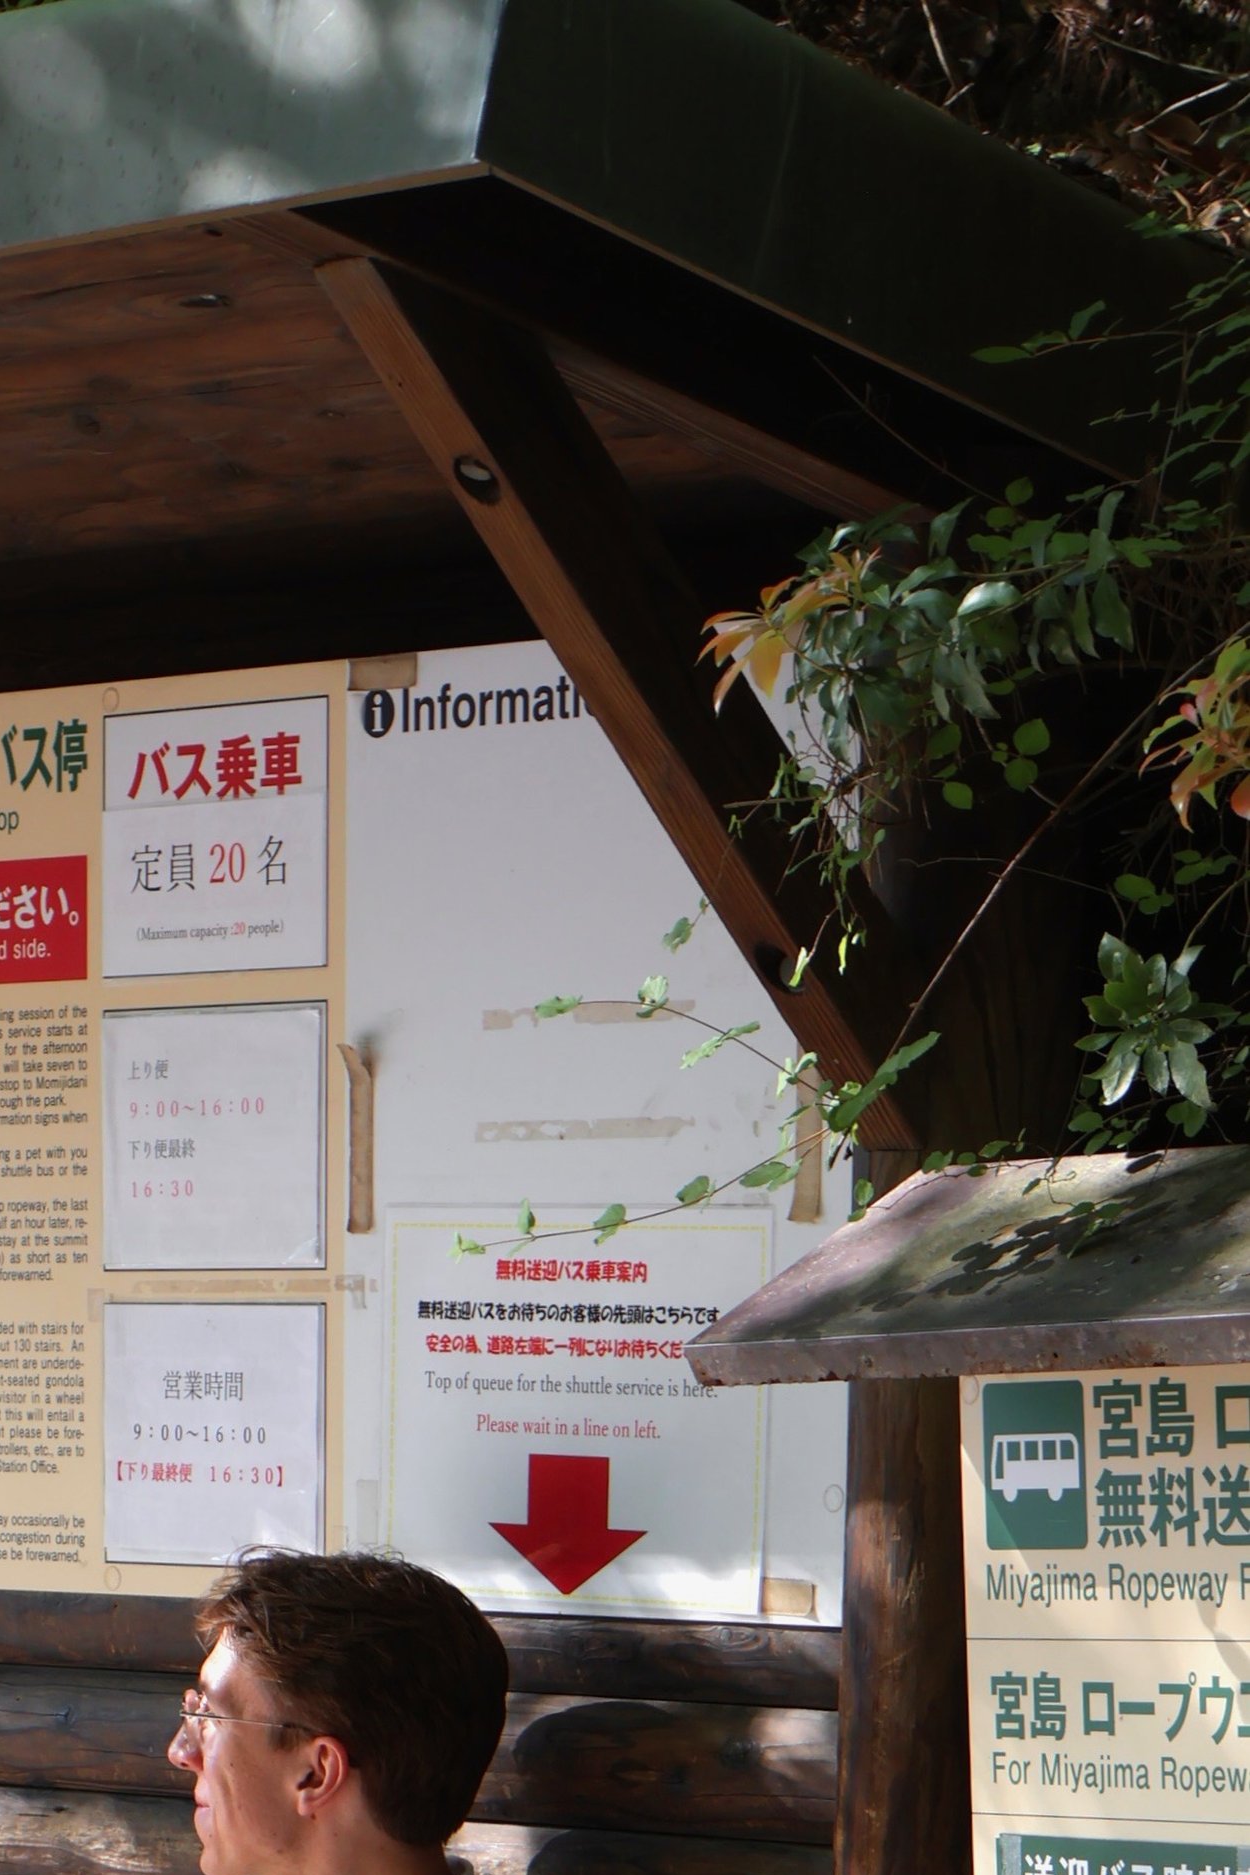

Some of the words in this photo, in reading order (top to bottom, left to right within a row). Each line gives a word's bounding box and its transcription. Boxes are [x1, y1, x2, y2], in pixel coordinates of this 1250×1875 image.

[127, 732, 302, 800] バス乗車
[130, 844, 195, 895] 定員
[210, 843, 245, 883] 20
[257, 835, 286, 885] 名
[137, 926, 187, 942] (Maximum
[190, 924, 228, 941] capacity
[248, 919, 284, 936] people)
[13, 938, 51, 959] side.
[19, 1008, 54, 1020] session
[59, 1006, 68, 1019] of
[73, 1006, 87, 1018] the
[128, 1060, 169, 1080] 上り便
[128, 1138, 195, 1160] 下り便最終
[132, 1180, 193, 1198] 16:30
[496, 1259, 647, 1282] 無料送迎バス乗車案内
[18, 1323, 38, 1334] with
[41, 1323, 68, 1335] stairs
[71, 1323, 84, 1335] for
[426, 1333, 685, 1359] 安全の為、道路左端に一列になりお待ちくだ
[163, 1370, 244, 1401] 営業時間
[425, 1371, 451, 1389] Top
[456, 1373, 468, 1388] of
[472, 1377, 513, 1394] queue
[517, 1373, 536, 1392] for
[540, 1375, 562, 1393] the
[566, 1375, 612, 1395] shuttle
[616, 1379, 664, 1396] service
[668, 1379, 678, 1397] is
[682, 1380, 718, 1398] here.
[476, 1414, 518, 1433] Please
[524, 1418, 550, 1434] wait
[555, 1418, 567, 1435] in
[572, 1423, 579, 1436] a
[584, 1419, 609, 1436] line
[613, 1425, 629, 1437] on
[634, 1420, 660, 1439] left.
[1093, 1377, 1194, 1459] 宮島
[1096, 1465, 1250, 1547] 無料送
[986, 1563, 1097, 1608] Miyajima
[1109, 1563, 1228, 1608] Ropeway
[990, 1671, 1066, 1740] 宮島
[992, 1752, 1030, 1785] For
[1041, 1753, 1150, 1793] Miyajima
[1161, 1757, 1250, 1797] Ropew
